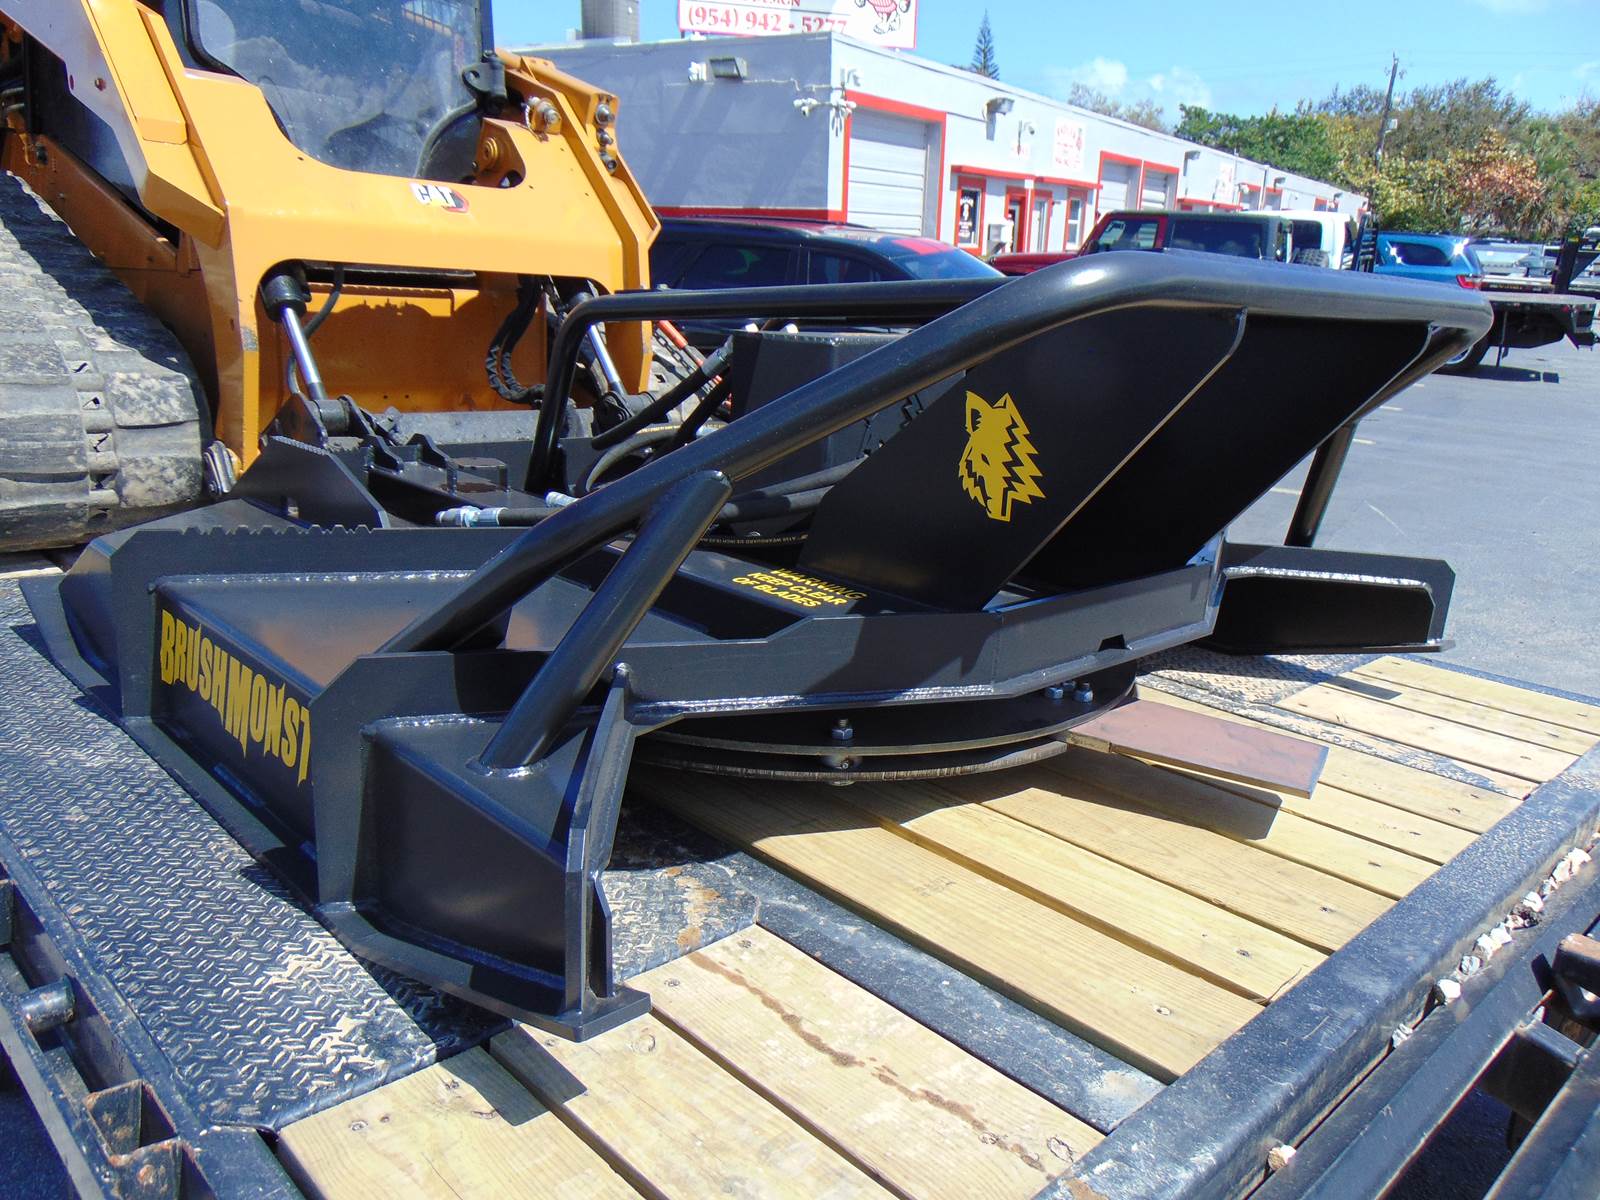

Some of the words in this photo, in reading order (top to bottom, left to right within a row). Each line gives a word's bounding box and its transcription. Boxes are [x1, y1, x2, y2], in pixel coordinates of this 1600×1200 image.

[688, 5, 739, 28] (954)
[745, 11, 782, 32] 942
[801, 16, 848, 35] 5277
[732, 577, 760, 586] OF
[753, 584, 822, 607] BLADES
[747, 572, 794, 587] KEEP
[789, 585, 847, 605] CLEAR
[770, 568, 867, 599] WARNING
